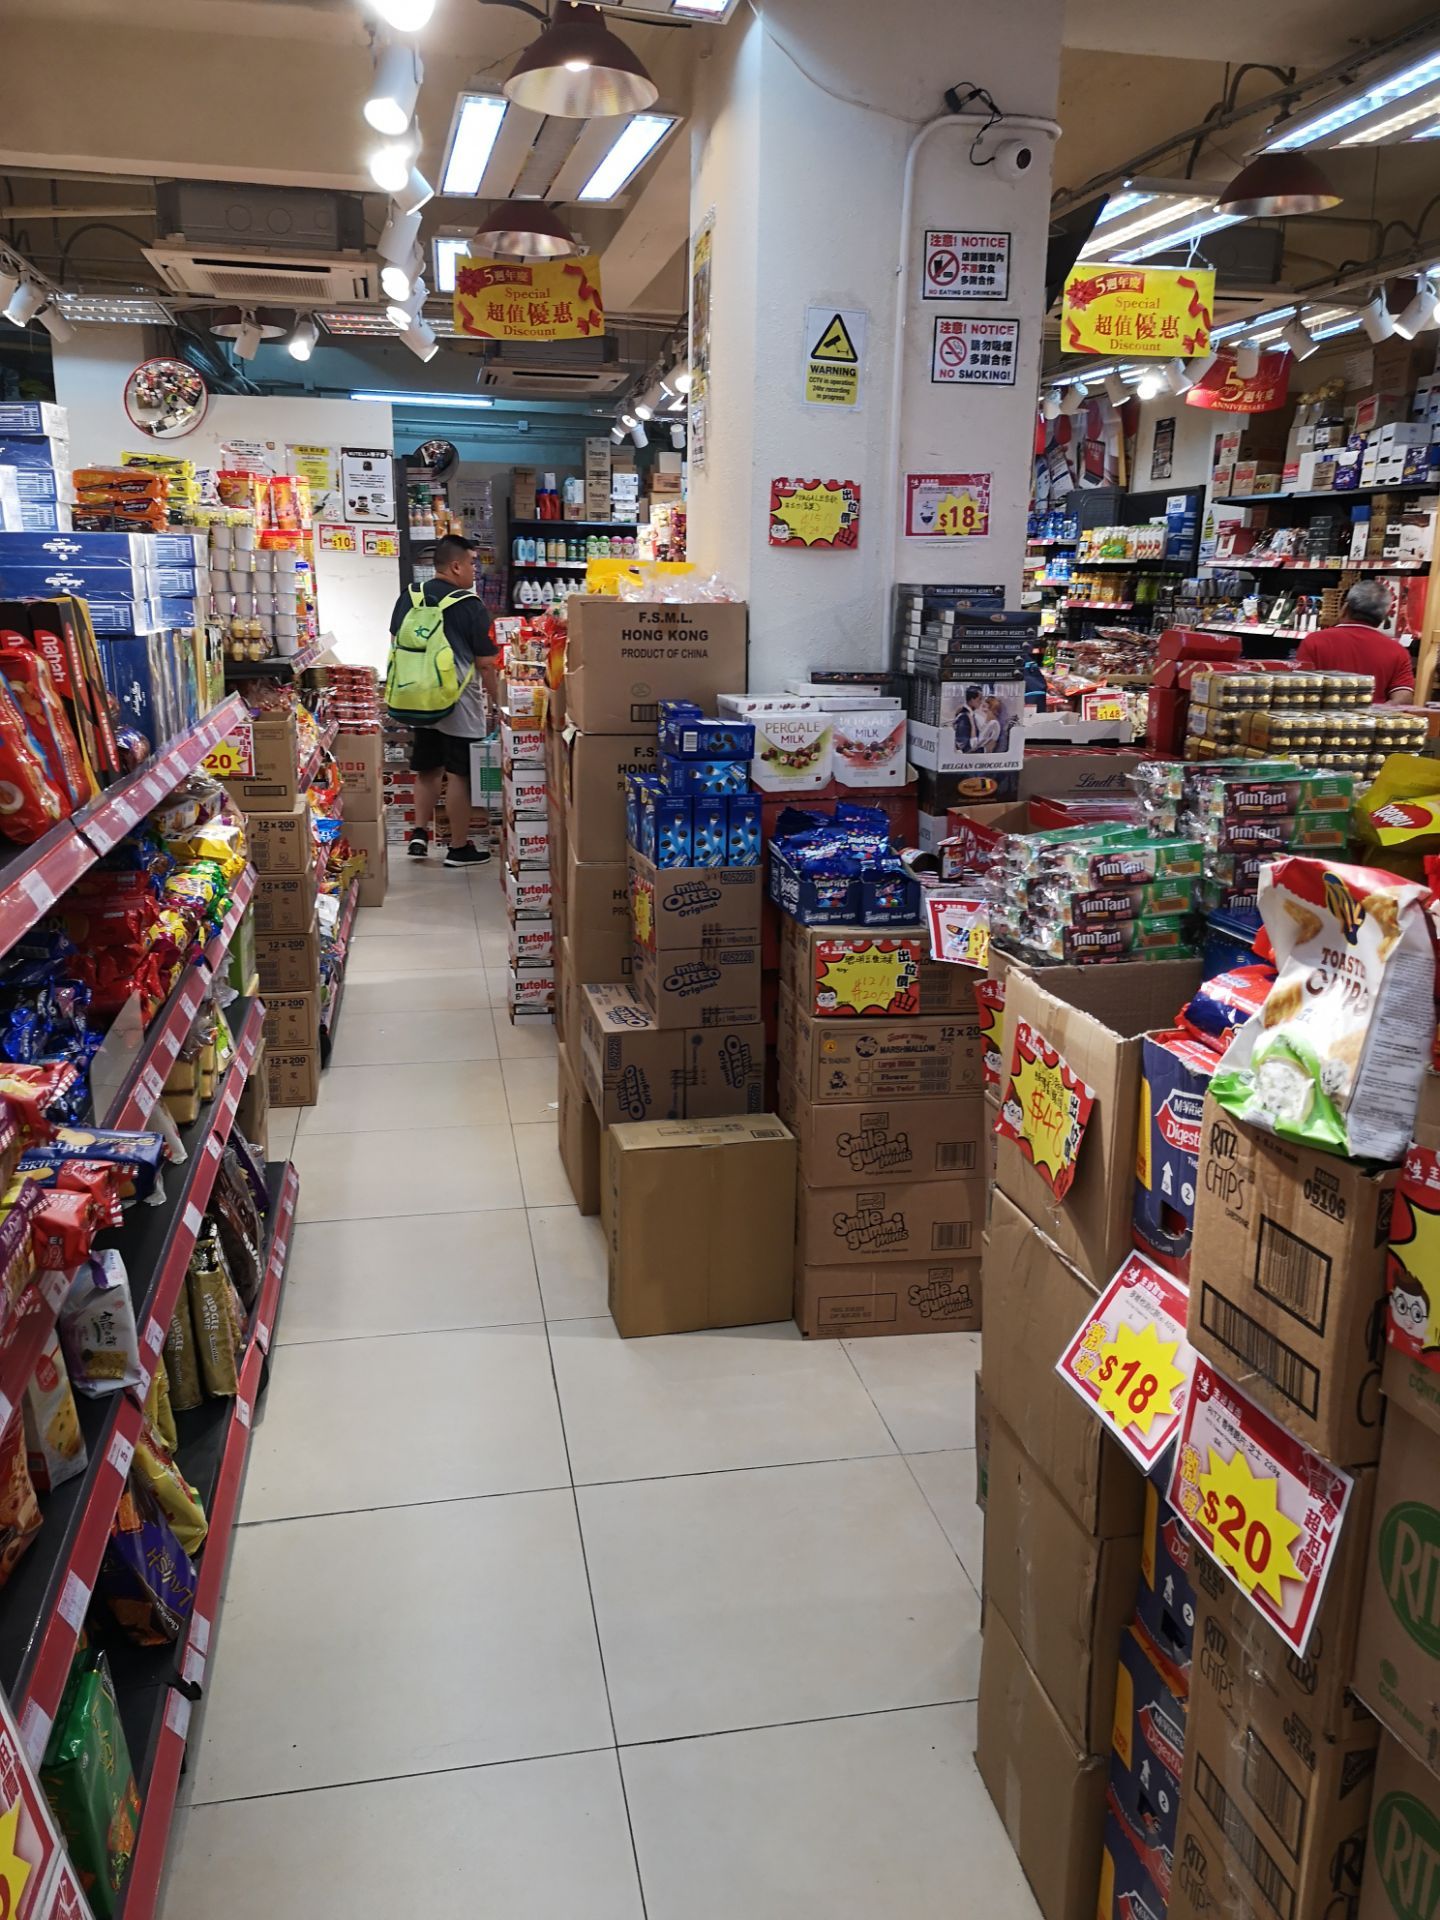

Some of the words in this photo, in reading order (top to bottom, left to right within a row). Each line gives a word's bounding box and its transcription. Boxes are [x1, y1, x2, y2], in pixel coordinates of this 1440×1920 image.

[930, 235, 957, 247] 注意!
[961, 237, 1006, 248] NOTICE
[505, 288, 550, 301] Special
[1116, 298, 1160, 311] Special
[486, 301, 573, 326] 超值優惠
[503, 326, 556, 336] Discount
[940, 322, 966, 334] 注意!
[971, 324, 1014, 335] NOTICE
[1094, 313, 1180, 339] 超值優惠
[1110, 340, 1160, 350] Discount
[970, 354, 1011, 366] 多謝合作
[810, 365, 856, 376] WARNING
[940, 369, 955, 378] NO
[959, 370, 1010, 380] SMOKING!
[940, 506, 975, 528] $18
[639, 612, 693, 623] F.S.M.L.
[622, 630, 663, 641] HONG
[668, 630, 708, 641] KONG
[621, 649, 665, 659] PRODUCT
[668, 649, 679, 659] OF
[681, 649, 708, 659] CHINA
[766, 722, 820, 734] PERGALE
[856, 728, 879, 738] MILK
[781, 735, 805, 744] MILK
[618, 763, 657, 774] HONG
[941, 762, 973, 770] BELGIAN
[974, 761, 1019, 770] CHOCOLATES
[1076, 773, 1116, 788] Lindt
[258, 821, 269, 829] 12
[675, 881, 707, 895] mini
[663, 888, 721, 912] OREO
[679, 903, 718, 918] Original
[288, 940, 305, 948] 200
[675, 962, 707, 976] mini
[663, 968, 721, 992] OREO
[679, 982, 718, 998] Original
[941, 1027, 955, 1037] 12
[966, 1026, 981, 1036] 20
[880, 1045, 936, 1054] MARSHMALLOW
[270, 1057, 280, 1065] 12
[289, 1056, 306, 1064] 200
[837, 1129, 888, 1157] Smile
[1211, 1122, 1238, 1160] RITZ
[850, 1133, 910, 1171] gummi
[1206, 1159, 1244, 1210] CHIPS
[1184, 1187, 1191, 1200] 2
[1303, 1179, 1346, 1220] 05106
[833, 1209, 883, 1237] Smile
[846, 1212, 905, 1250] gummi
[908, 1282, 951, 1306] Smile
[919, 1284, 970, 1318] gummi
[202, 1293, 220, 1331] FUDGEE
[1099, 1355, 1159, 1414] $18
[1203, 1490, 1272, 1575] $20
[1185, 1608, 1192, 1621] 2
